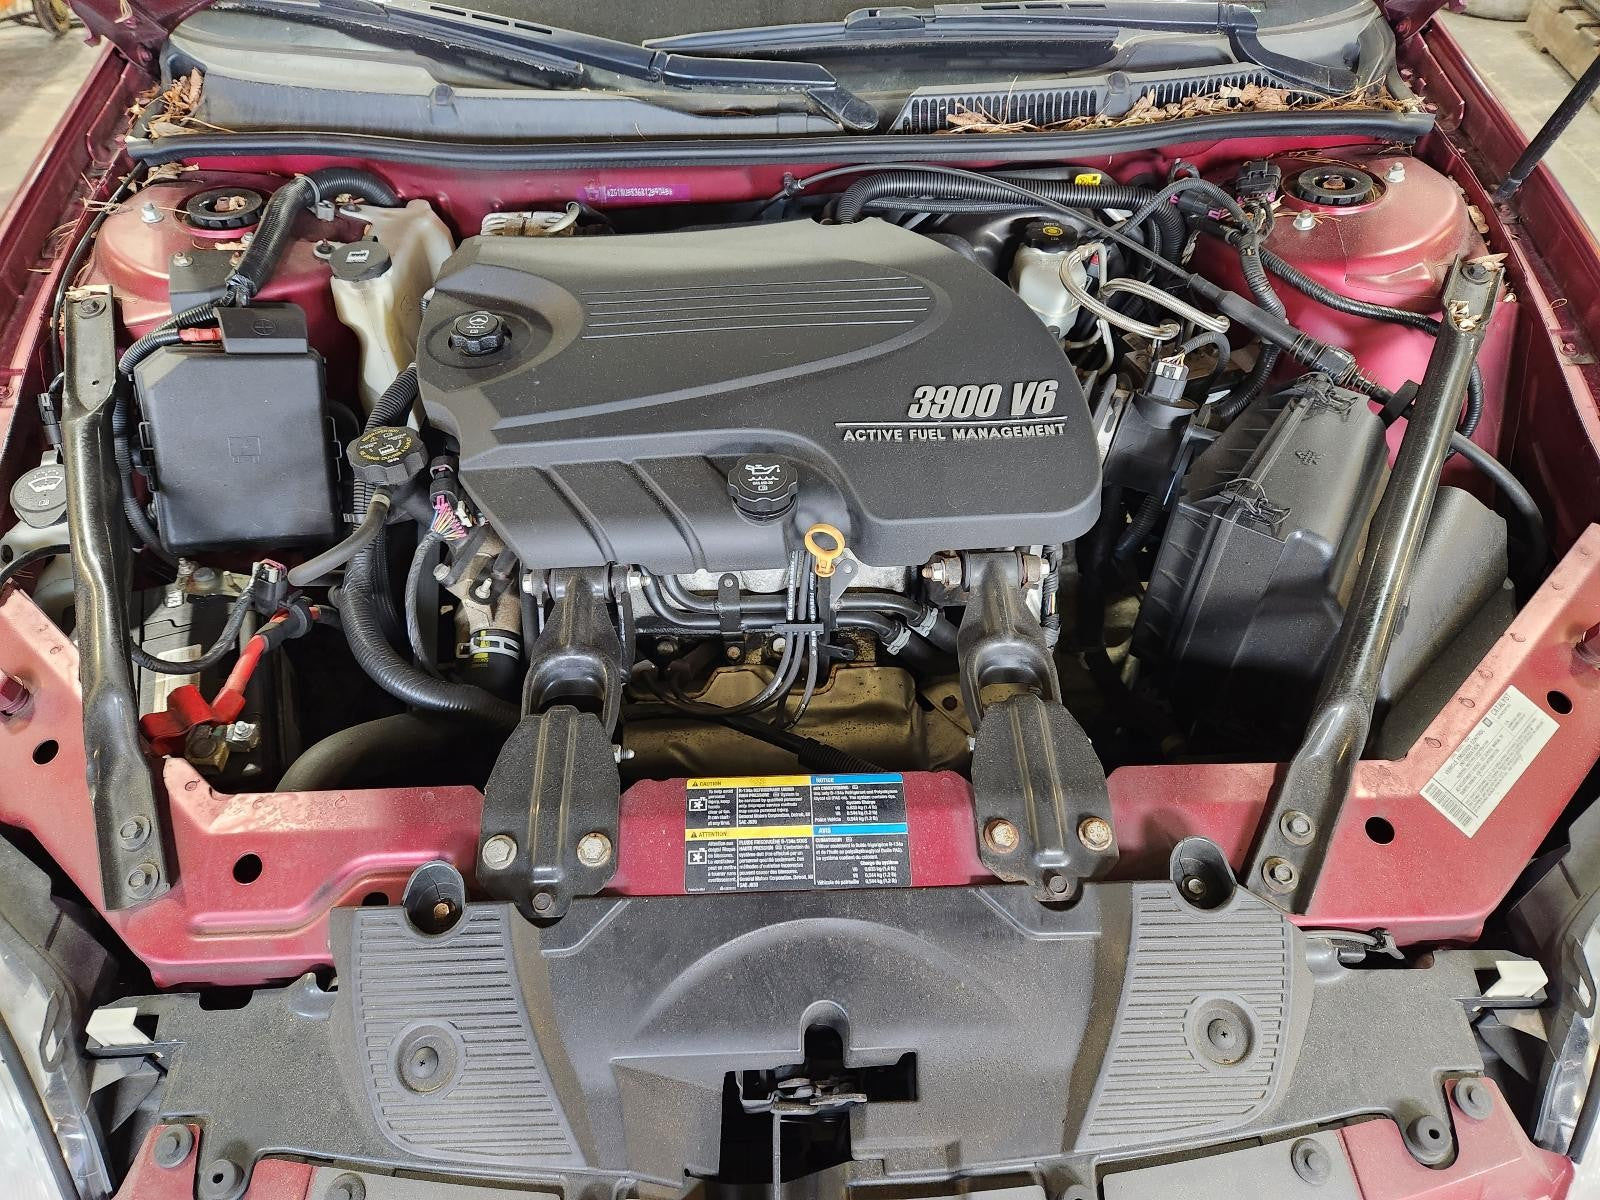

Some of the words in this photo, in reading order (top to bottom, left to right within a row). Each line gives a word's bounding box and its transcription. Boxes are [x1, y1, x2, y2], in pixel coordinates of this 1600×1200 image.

[907, 383, 1003, 419] 3900
[1010, 380, 1059, 416] V6
[843, 429, 903, 442] ACTIVE
[909, 428, 946, 441] FUEL
[952, 423, 1065, 441] MANAGEMENT
